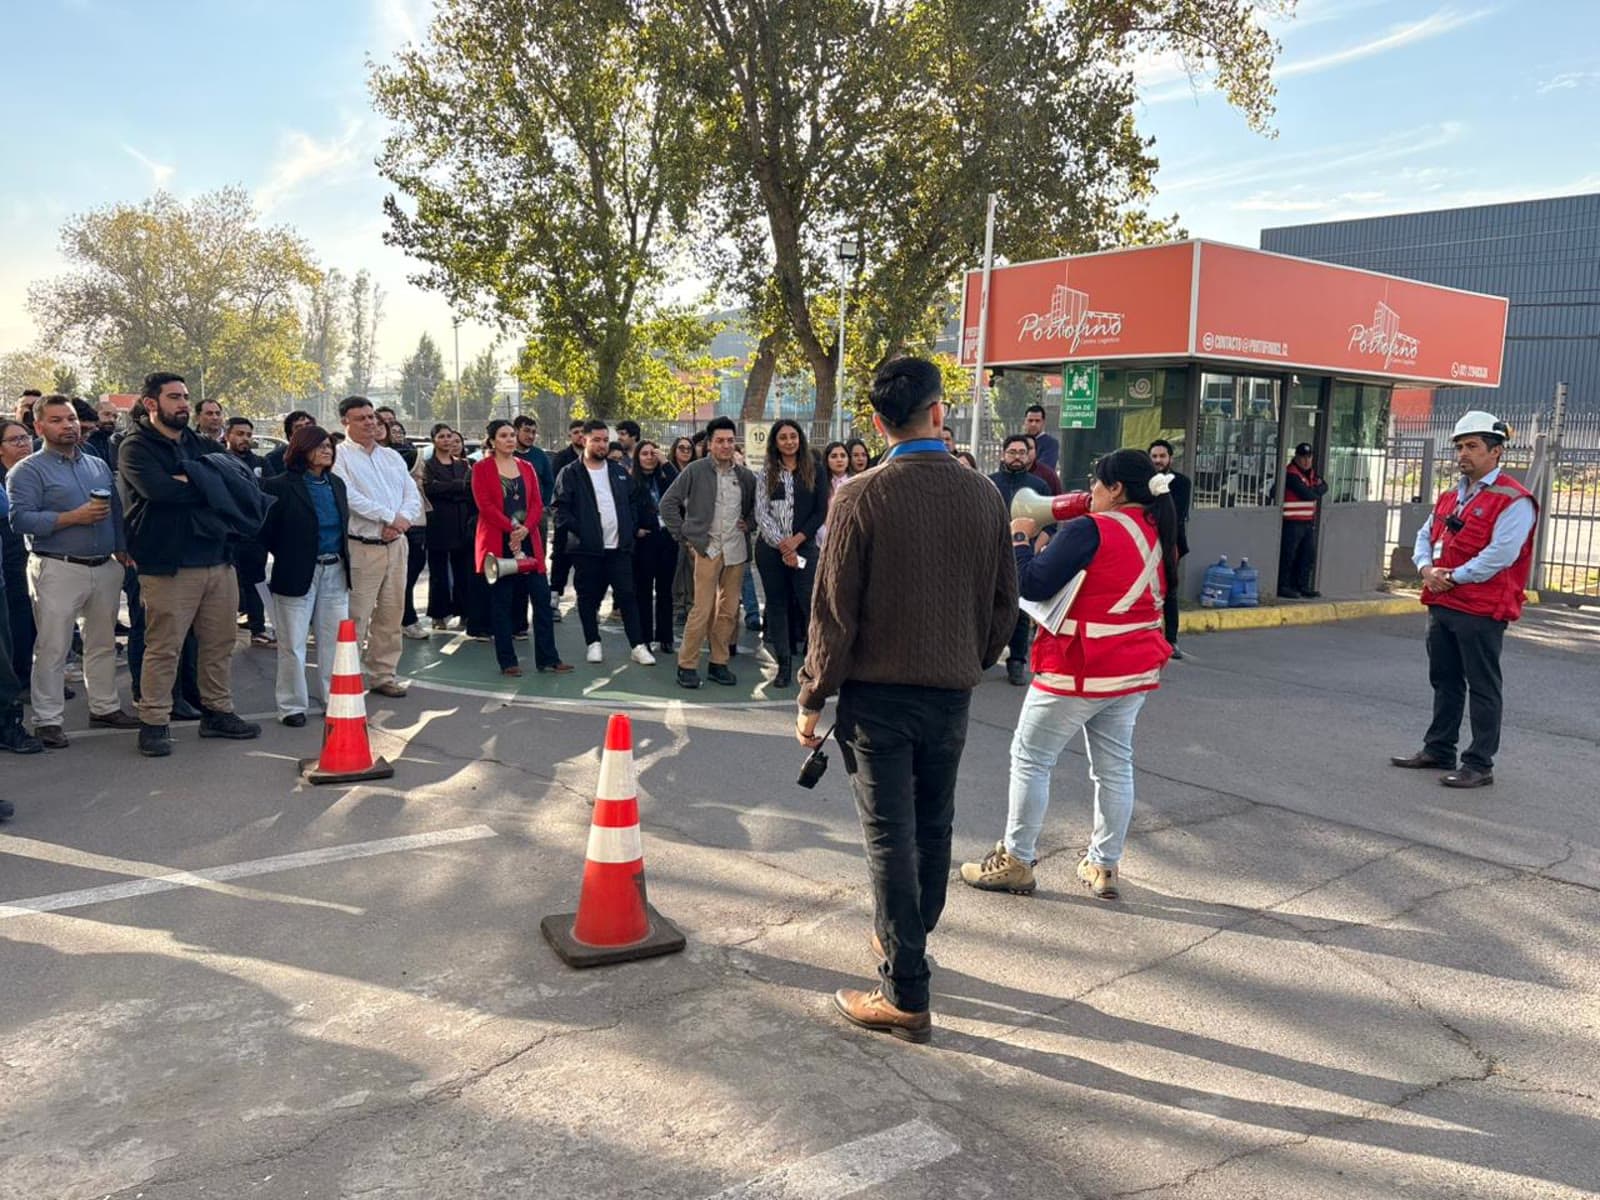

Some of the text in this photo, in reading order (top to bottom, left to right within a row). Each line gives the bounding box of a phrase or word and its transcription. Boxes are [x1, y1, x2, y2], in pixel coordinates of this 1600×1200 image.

[1018, 310, 1121, 354] Portofino
[1347, 324, 1417, 370] Portofino
[753, 431, 766, 442] 10
